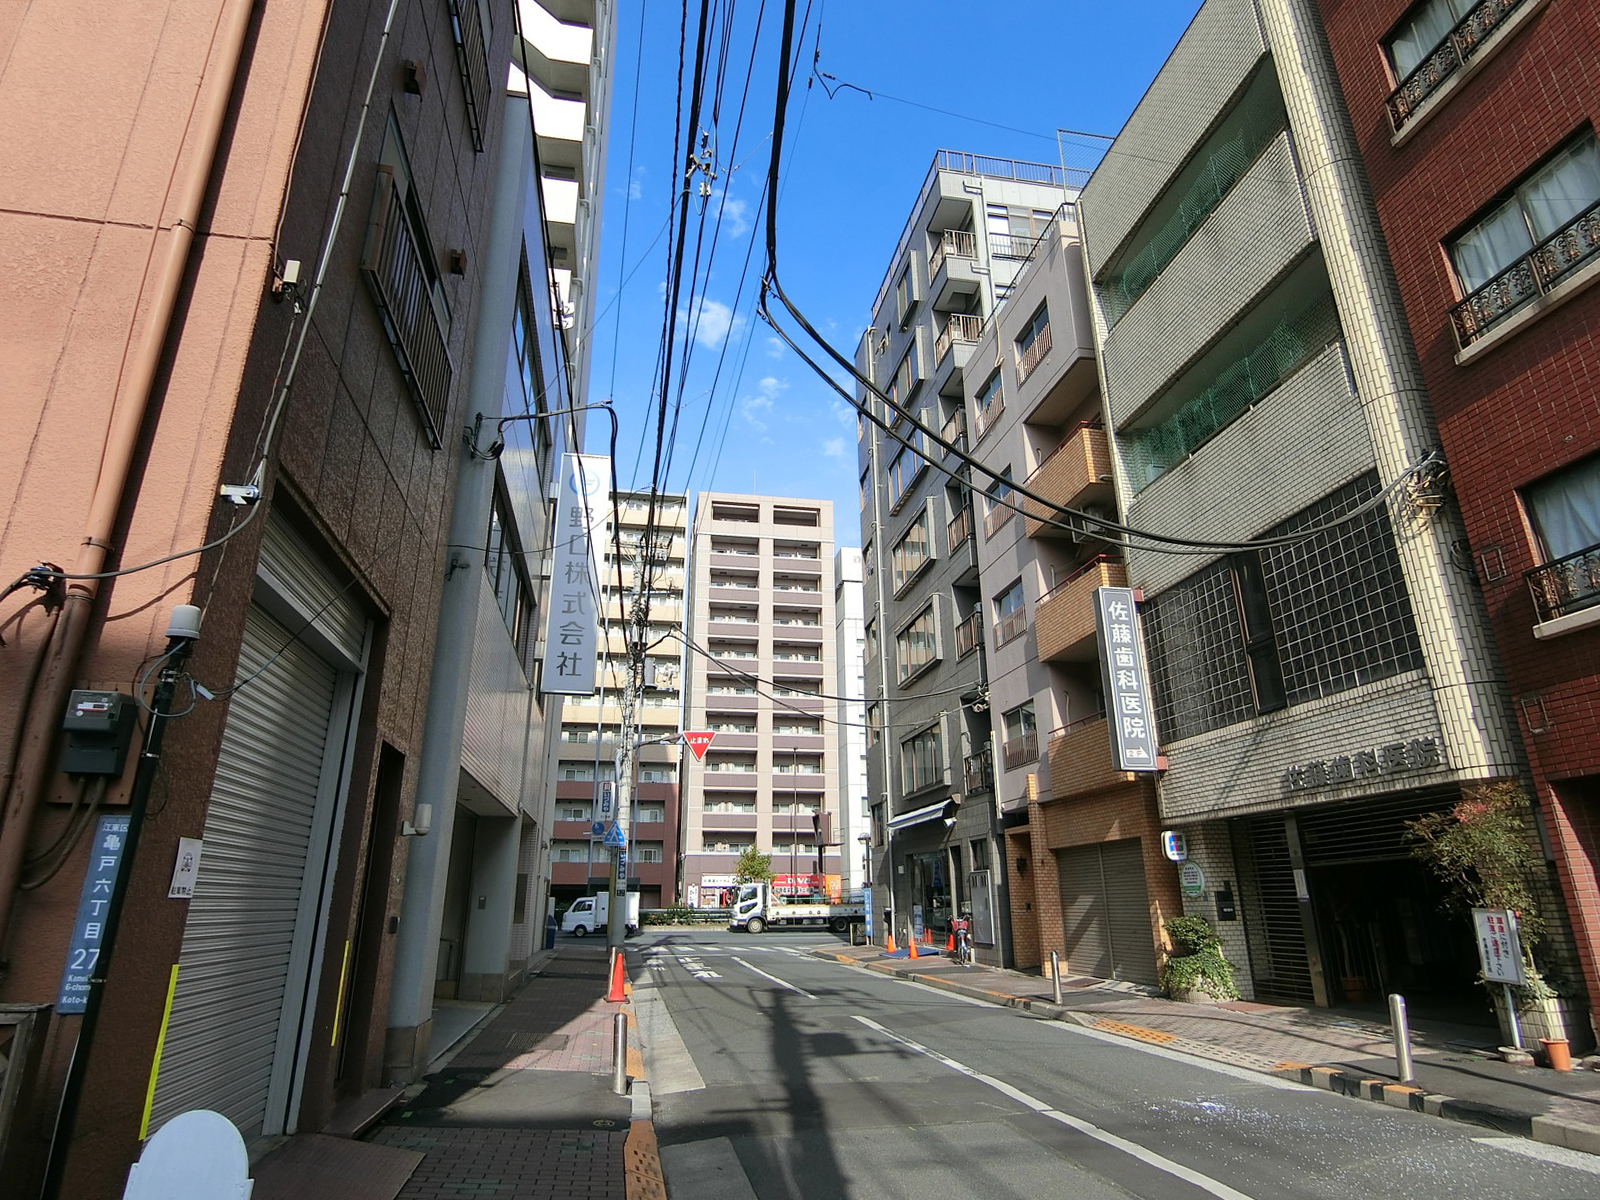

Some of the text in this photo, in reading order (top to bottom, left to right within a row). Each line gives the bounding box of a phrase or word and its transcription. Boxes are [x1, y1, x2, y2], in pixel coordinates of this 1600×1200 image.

[556, 505, 595, 677] 野口株式会社
[1108, 600, 1146, 739] 佐藤歯科医院
[689, 736, 709, 745] 止まれ
[1286, 736, 1443, 790] 佐藤歯科医院
[102, 822, 129, 832] 江東区
[84, 834, 121, 940] 亀戸六丁目
[70, 948, 101, 970] 27
[678, 956, 722, 978] 止まれ
[65, 983, 92, 991] 6-chom
[62, 996, 88, 1004] Koto-k
